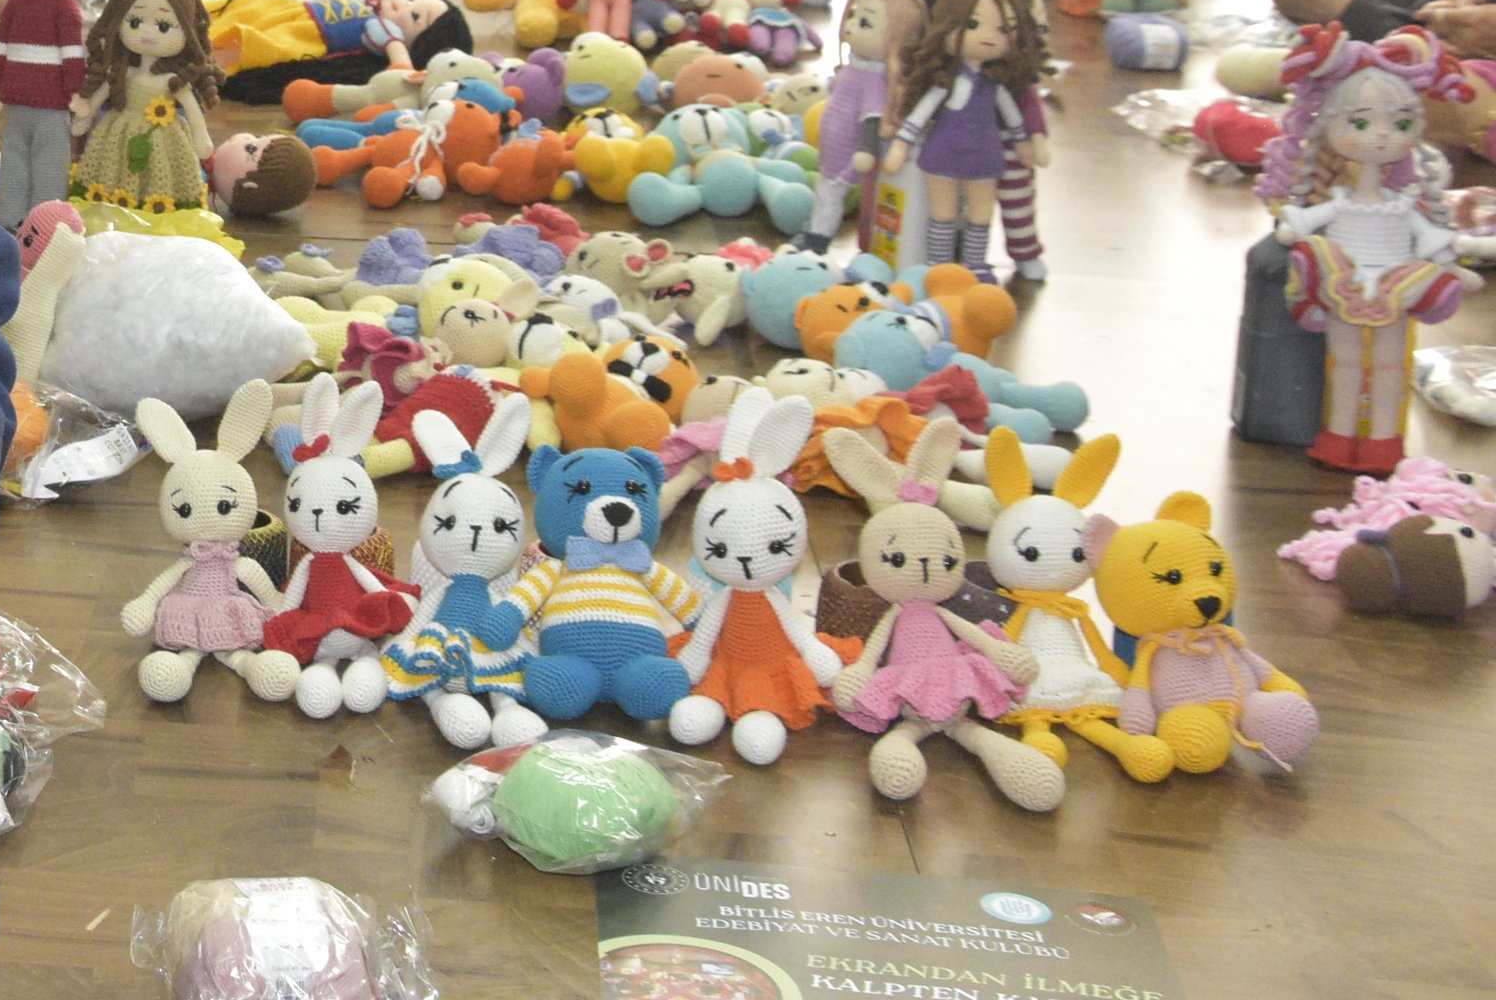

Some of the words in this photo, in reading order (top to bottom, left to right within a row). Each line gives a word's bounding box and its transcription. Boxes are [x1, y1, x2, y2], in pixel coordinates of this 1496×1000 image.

[695, 916, 819, 935] EDEBİYAT
[825, 927, 860, 939] VE
[866, 930, 953, 948] SANAT
[719, 904, 795, 921] BİTLİS
[800, 911, 866, 927] EREN
[870, 916, 1045, 943] ÜNİVERSİTESİ
[806, 953, 1007, 987] EKRANDAN
[1023, 973, 1165, 1000] İLMEĞE
[811, 974, 979, 1000] KALPTEN
